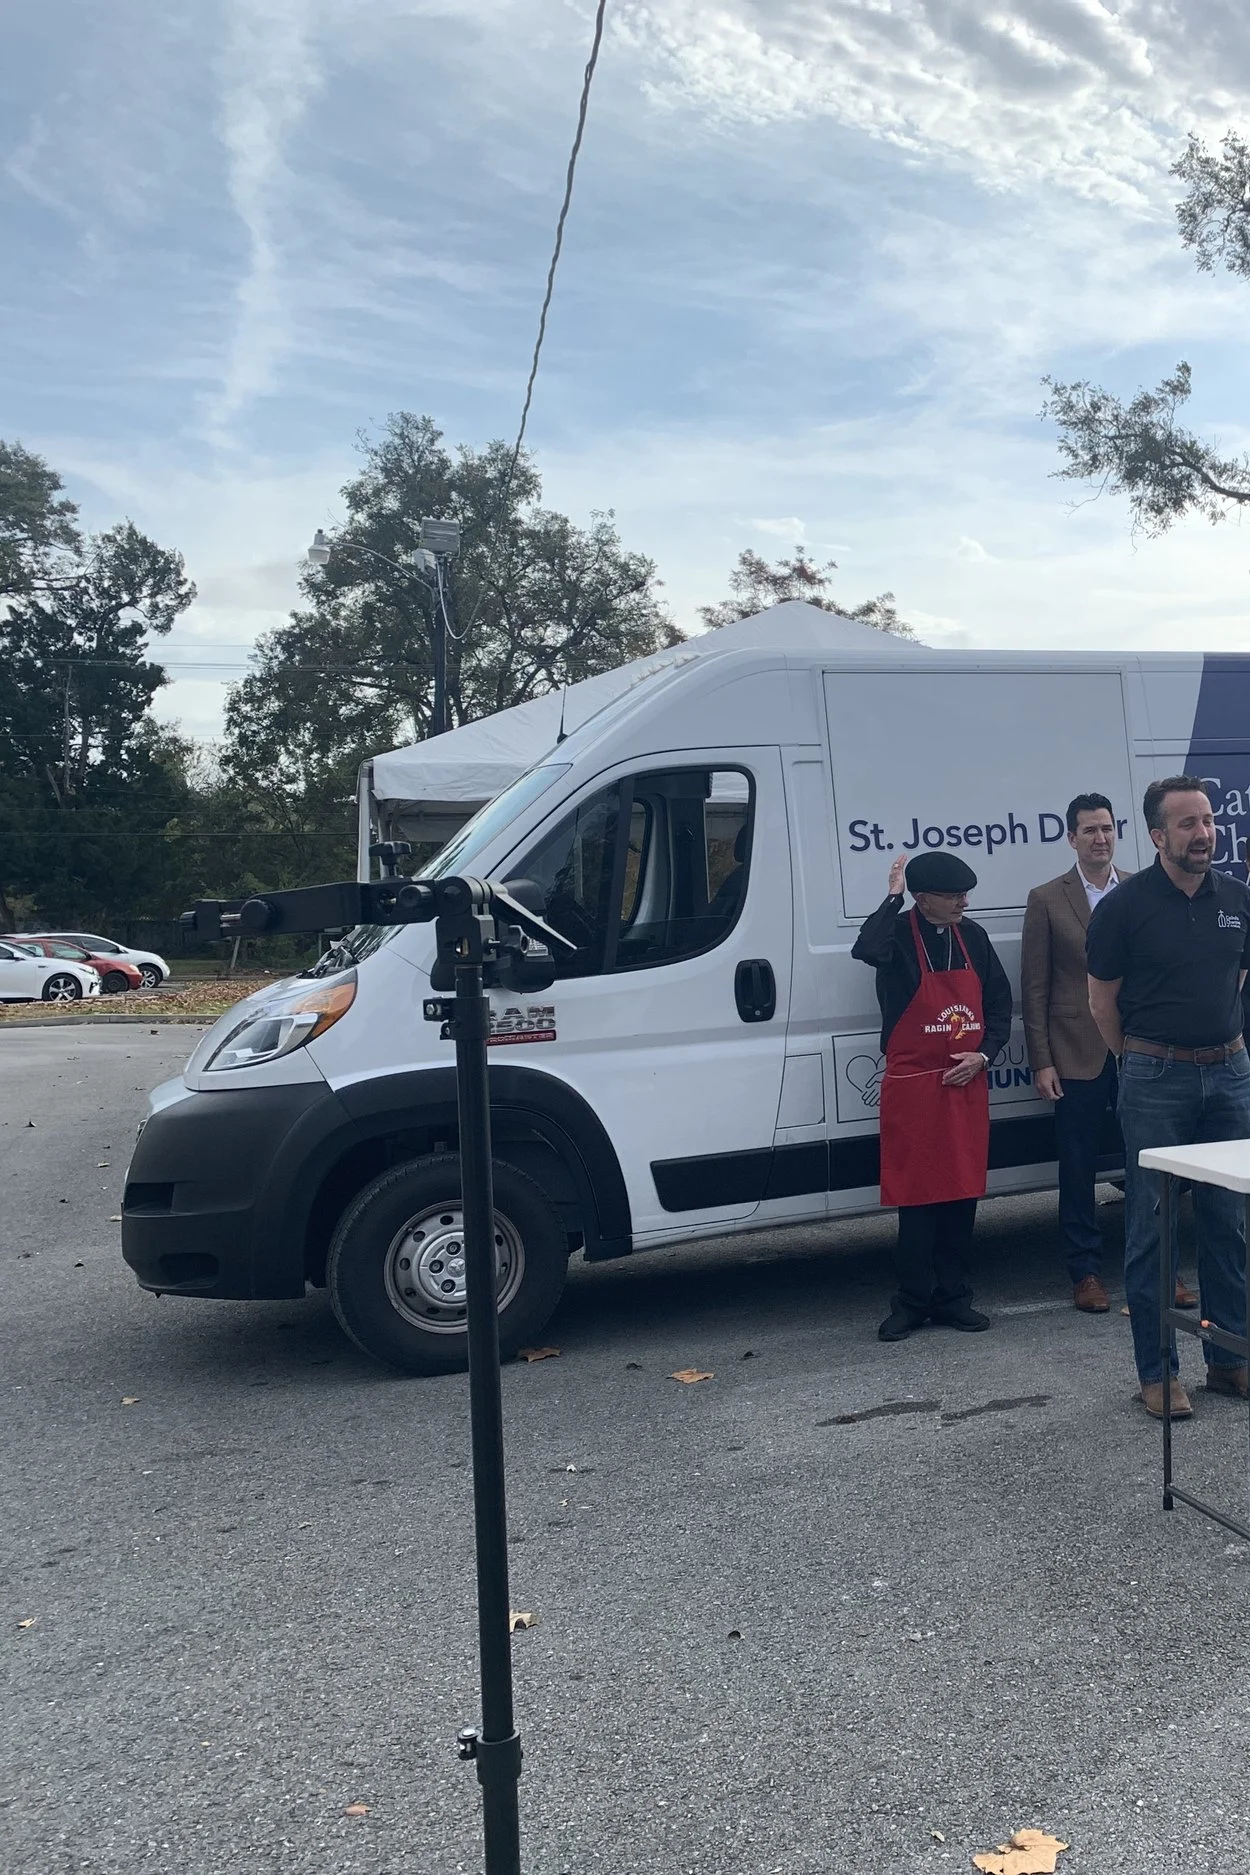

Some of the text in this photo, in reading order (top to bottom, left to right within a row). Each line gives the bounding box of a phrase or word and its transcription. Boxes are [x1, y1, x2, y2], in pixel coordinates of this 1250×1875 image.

[848, 819, 895, 852] St.
[901, 812, 1029, 856] Joseph
[924, 1023, 952, 1034] RAGIN
